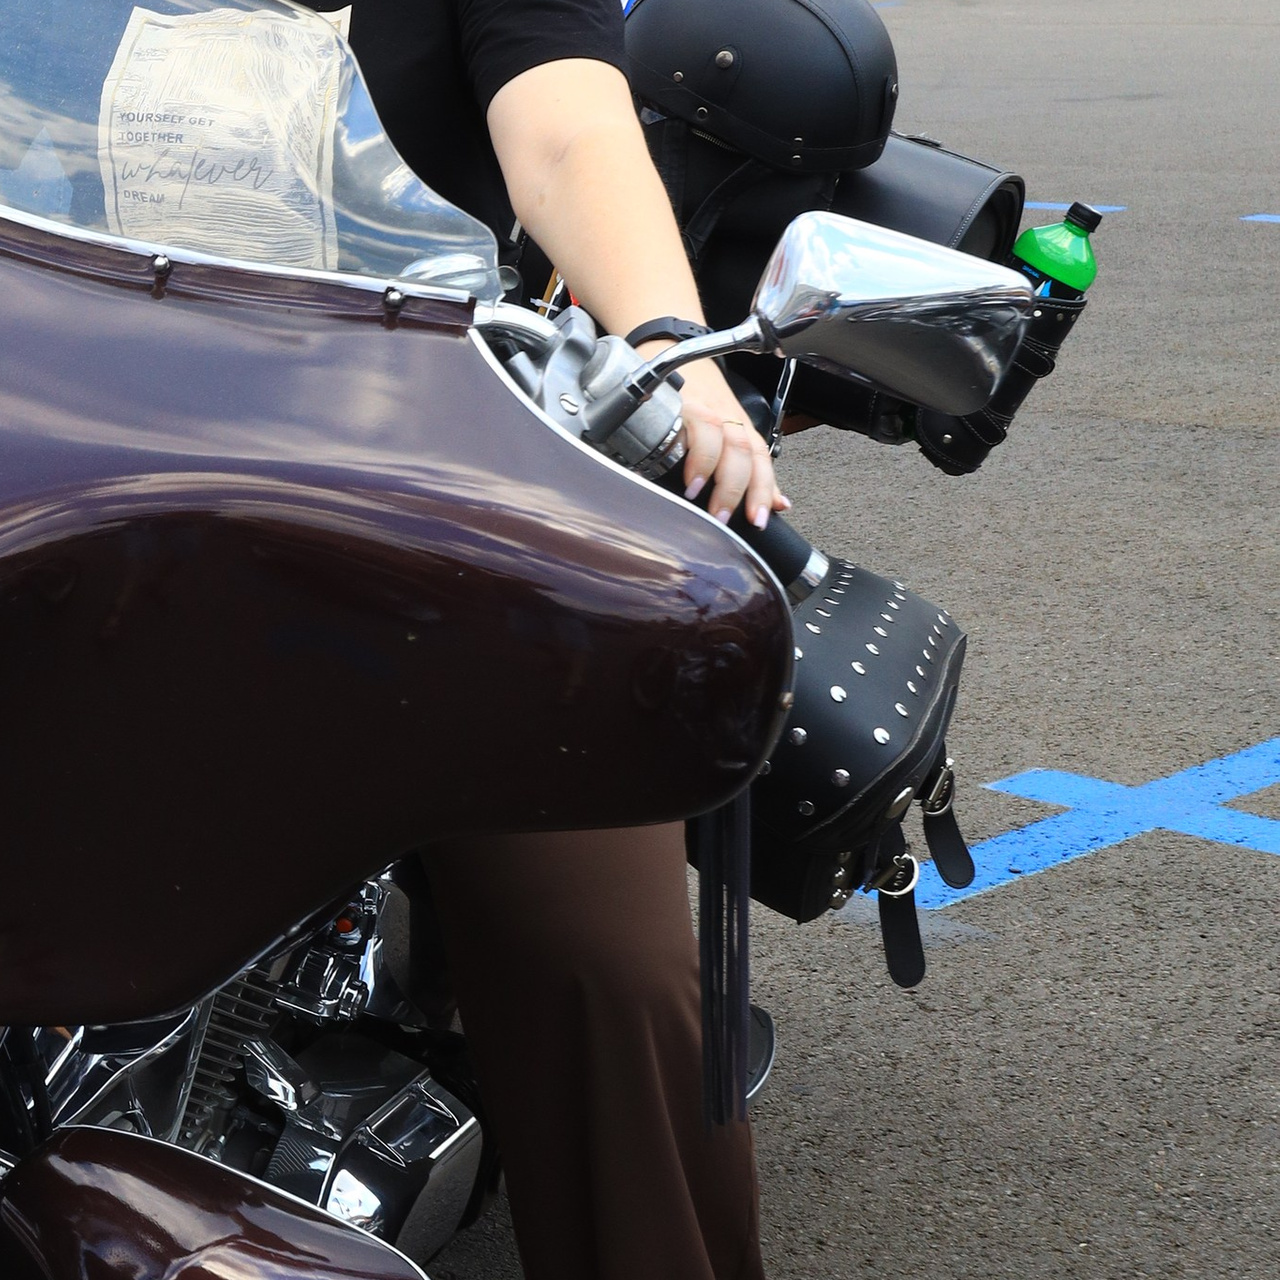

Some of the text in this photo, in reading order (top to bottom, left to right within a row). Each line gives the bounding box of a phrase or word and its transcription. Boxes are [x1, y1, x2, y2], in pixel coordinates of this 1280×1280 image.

[119, 112, 215, 127] YOURSELF GET
[119, 131, 183, 144] TOGETHER
[123, 189, 165, 204] DREAM
